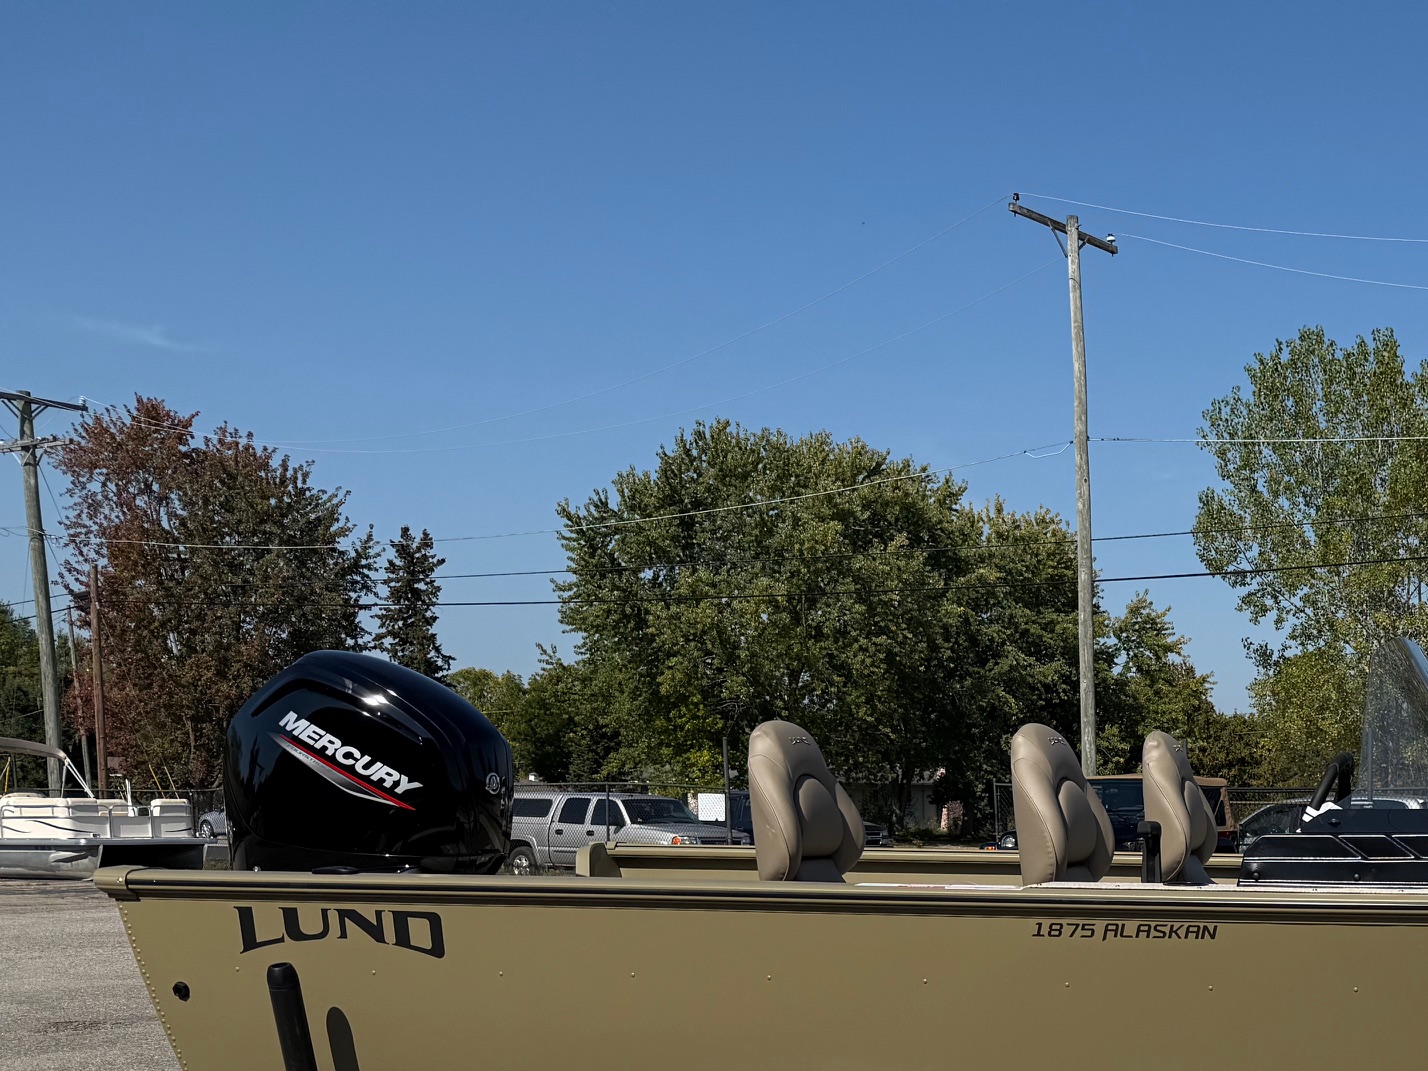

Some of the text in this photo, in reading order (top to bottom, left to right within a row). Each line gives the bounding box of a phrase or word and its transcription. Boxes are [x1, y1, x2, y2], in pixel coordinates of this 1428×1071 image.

[278, 710, 424, 794] MERCURY
[233, 906, 445, 959] LUND
[1031, 922, 1218, 942] 1875 ALASKAN
